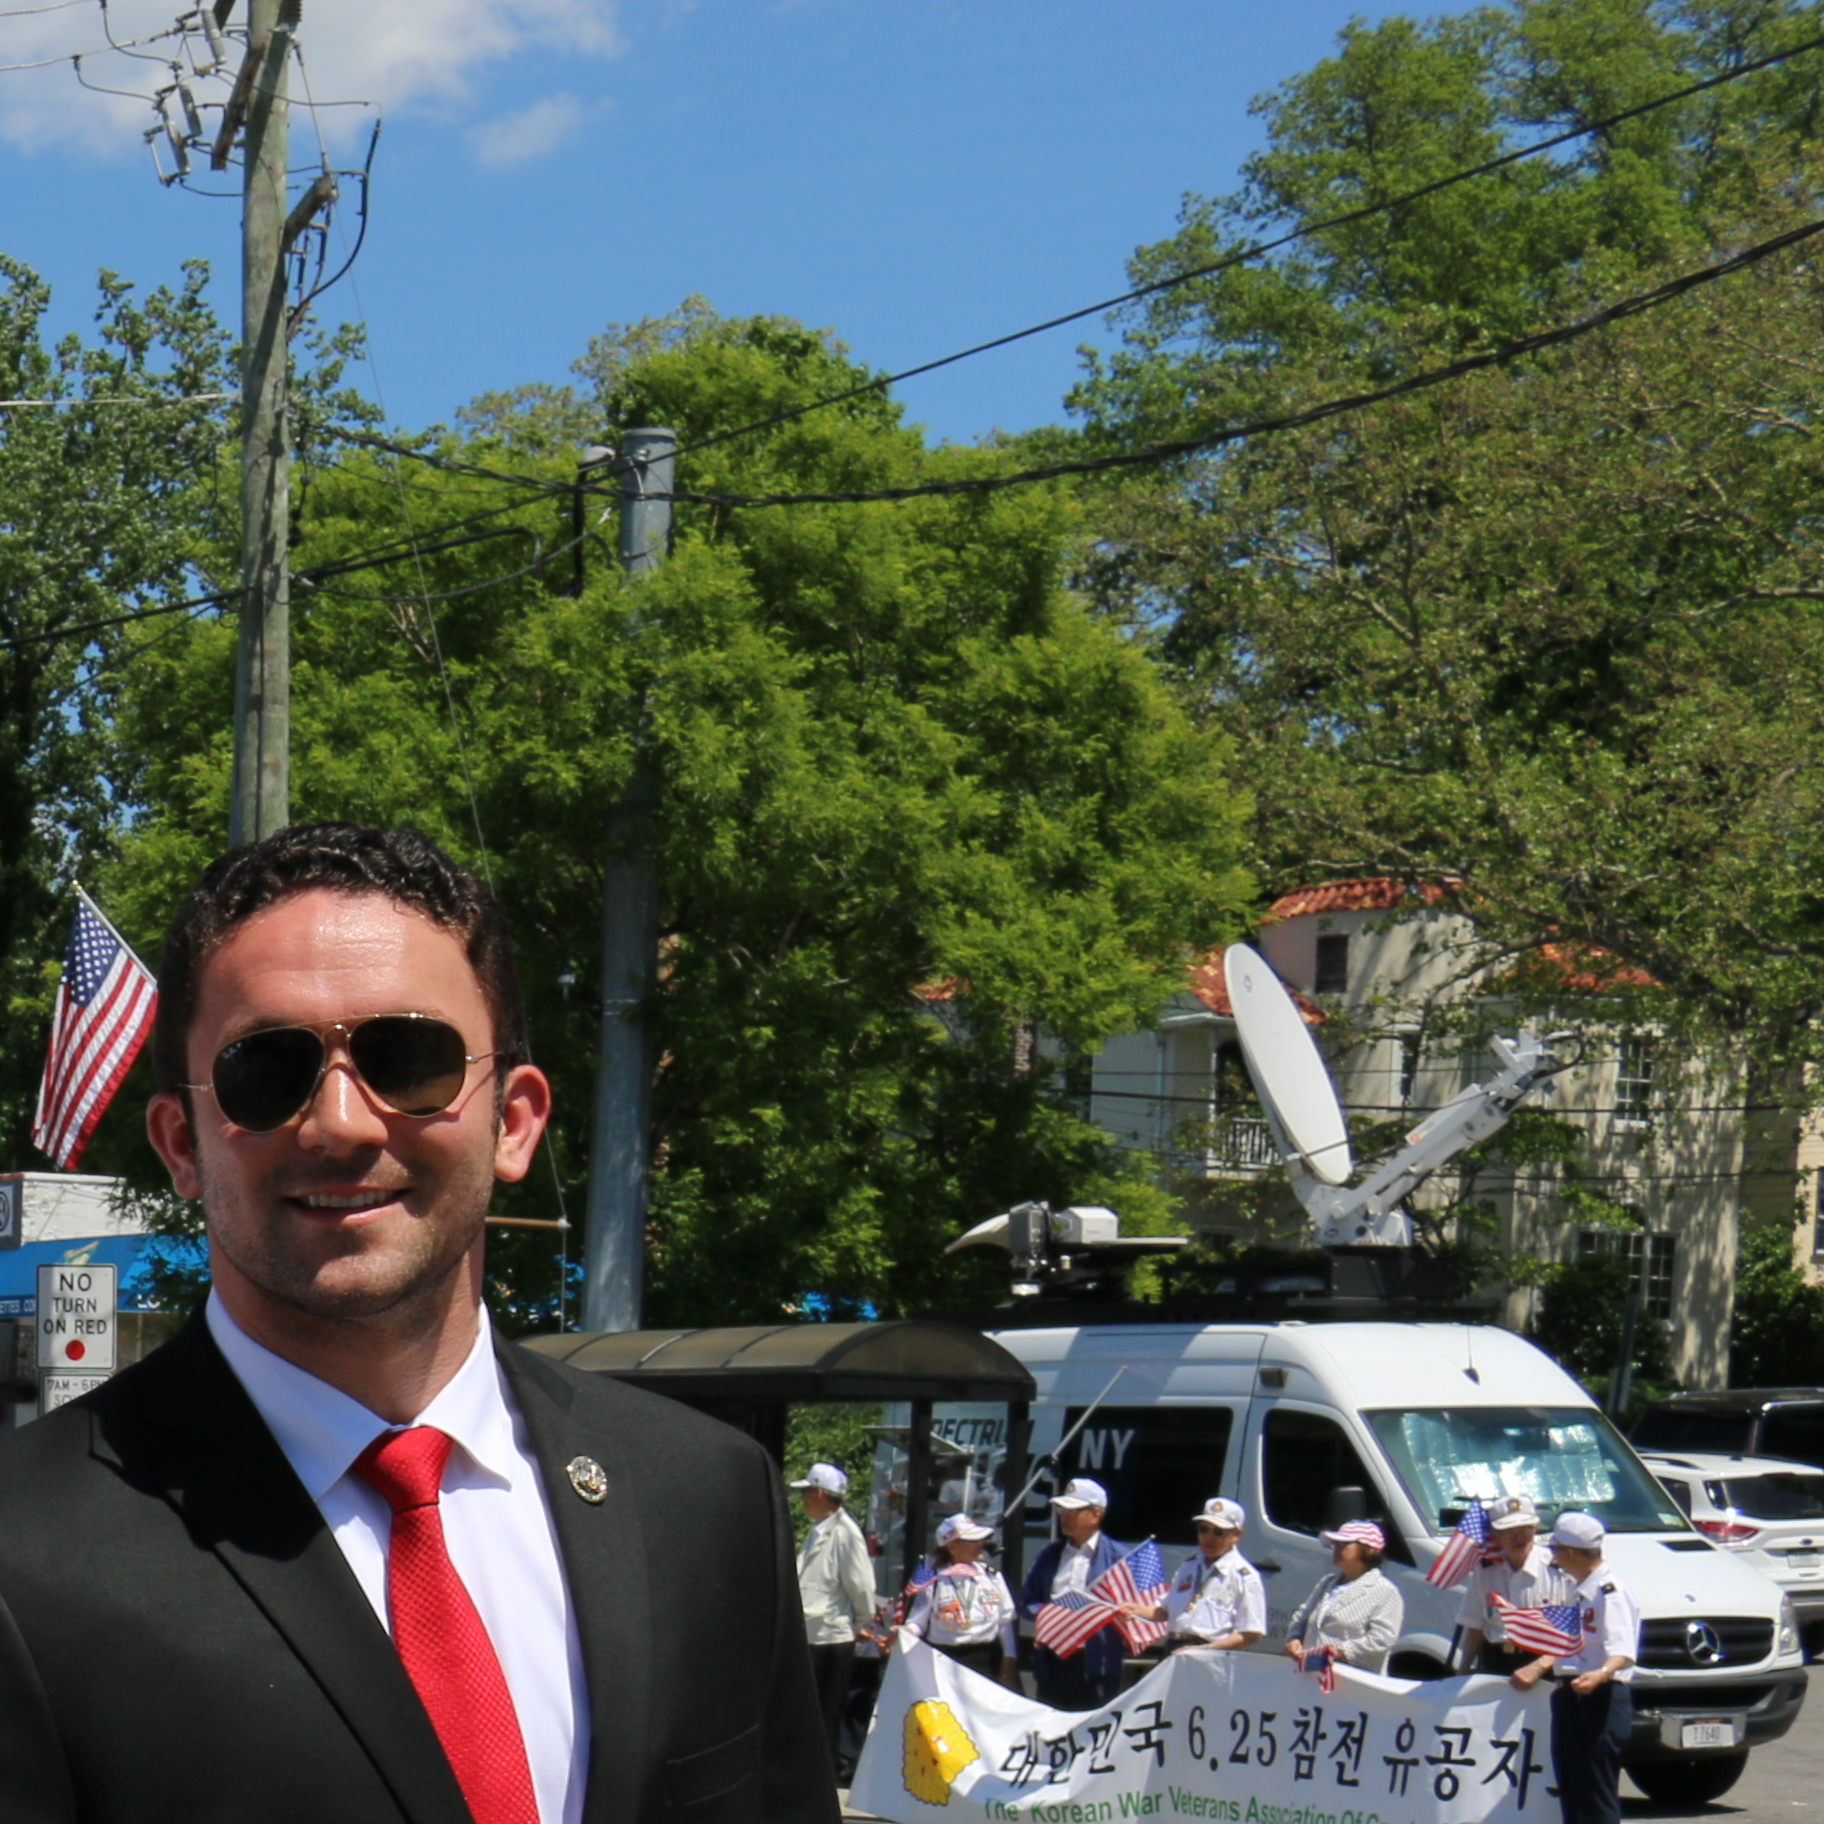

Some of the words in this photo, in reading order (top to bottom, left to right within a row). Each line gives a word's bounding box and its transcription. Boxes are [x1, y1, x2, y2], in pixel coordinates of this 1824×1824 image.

[59, 1273, 92, 1292] NO
[53, 1298, 97, 1313] TURN
[43, 1320, 66, 1334] ON
[75, 1320, 107, 1334] RED
[47, 1379, 70, 1391] 7AM
[1079, 1428, 1135, 1469] NY
[998, 1700, 1173, 1790] 대한민국
[1383, 1717, 1560, 1810] 유공자
[985, 1797, 1020, 1821] The
[1030, 1799, 1112, 1824] Korean
[1117, 1790, 1165, 1818] War
[1168, 1786, 1240, 1822] Veterans
